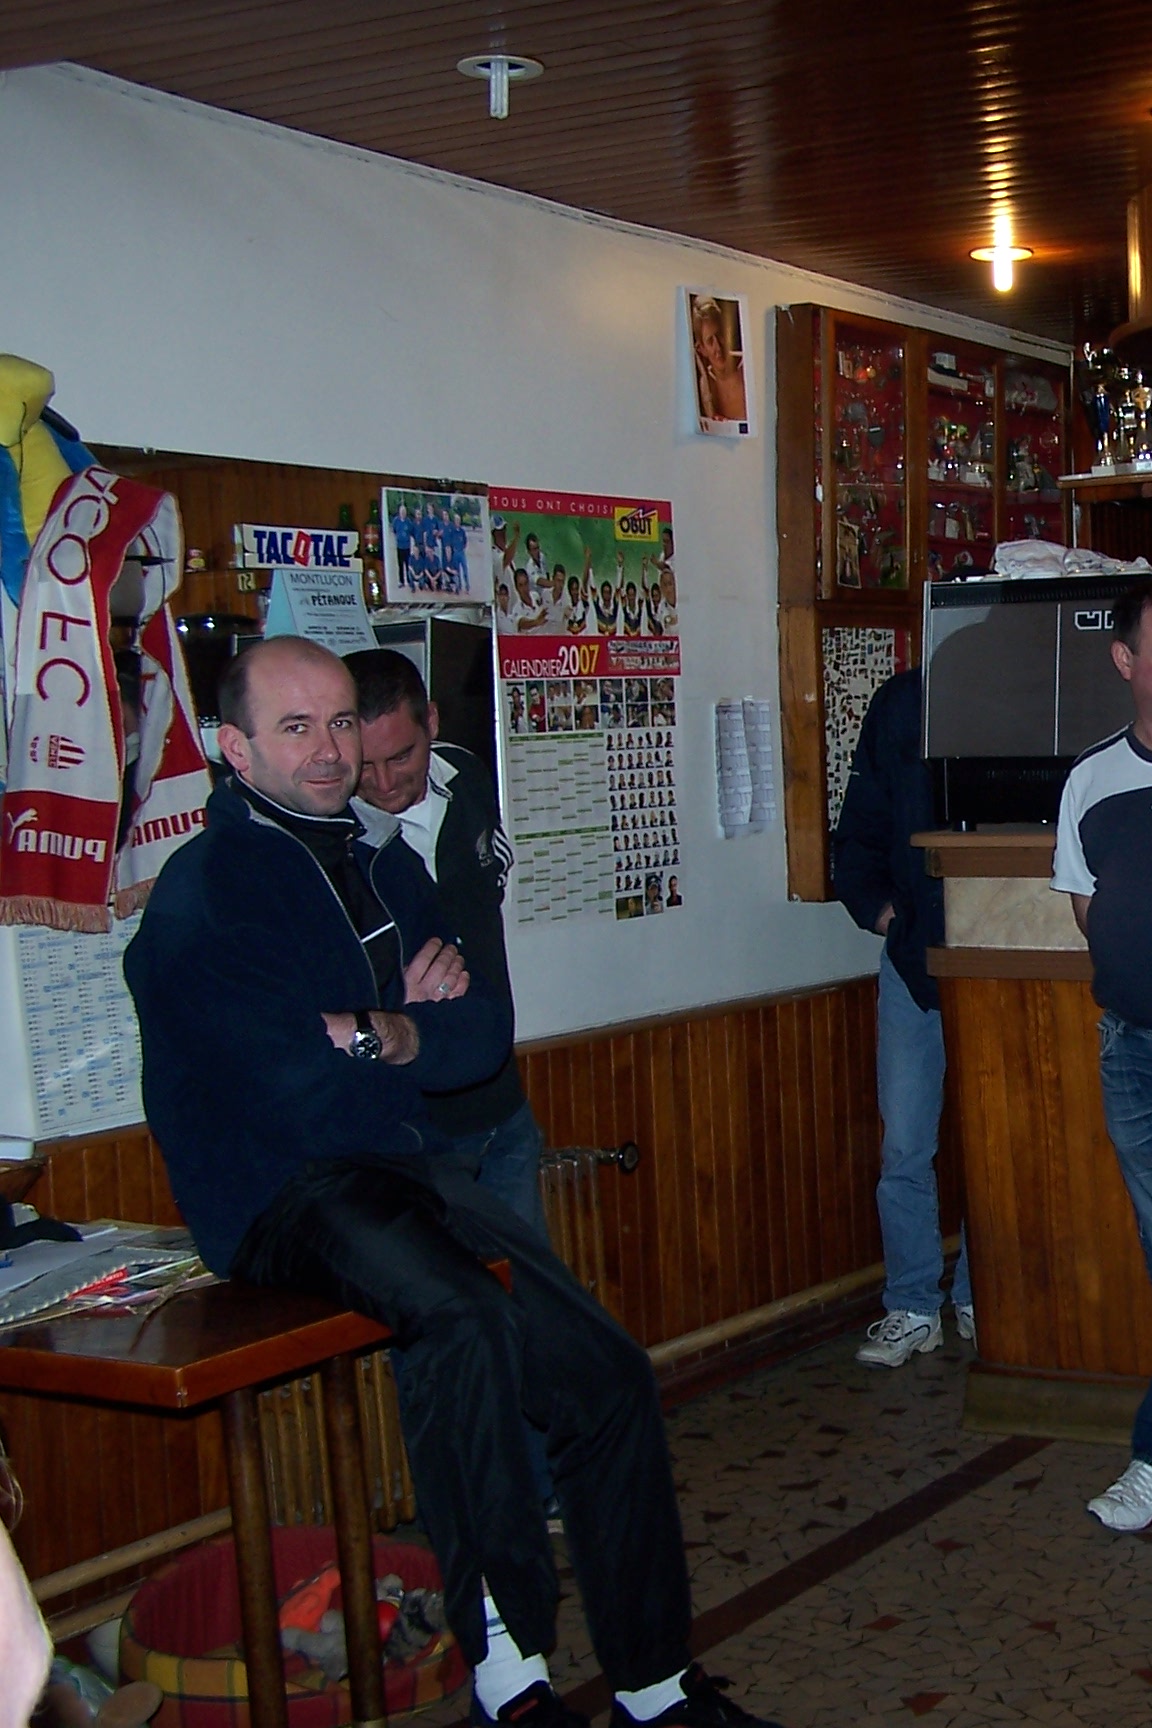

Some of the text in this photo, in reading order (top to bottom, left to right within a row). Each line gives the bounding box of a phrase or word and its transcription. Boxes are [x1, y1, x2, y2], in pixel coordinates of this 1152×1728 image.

[492, 496, 614, 514] TOUS ONT CHOISI
[620, 516, 652, 536] OBUT
[290, 573, 353, 587] MONTLUÇON
[311, 592, 358, 606] PÉTANQUE
[503, 658, 561, 678] CALENDRIER
[558, 644, 599, 675] 2007
